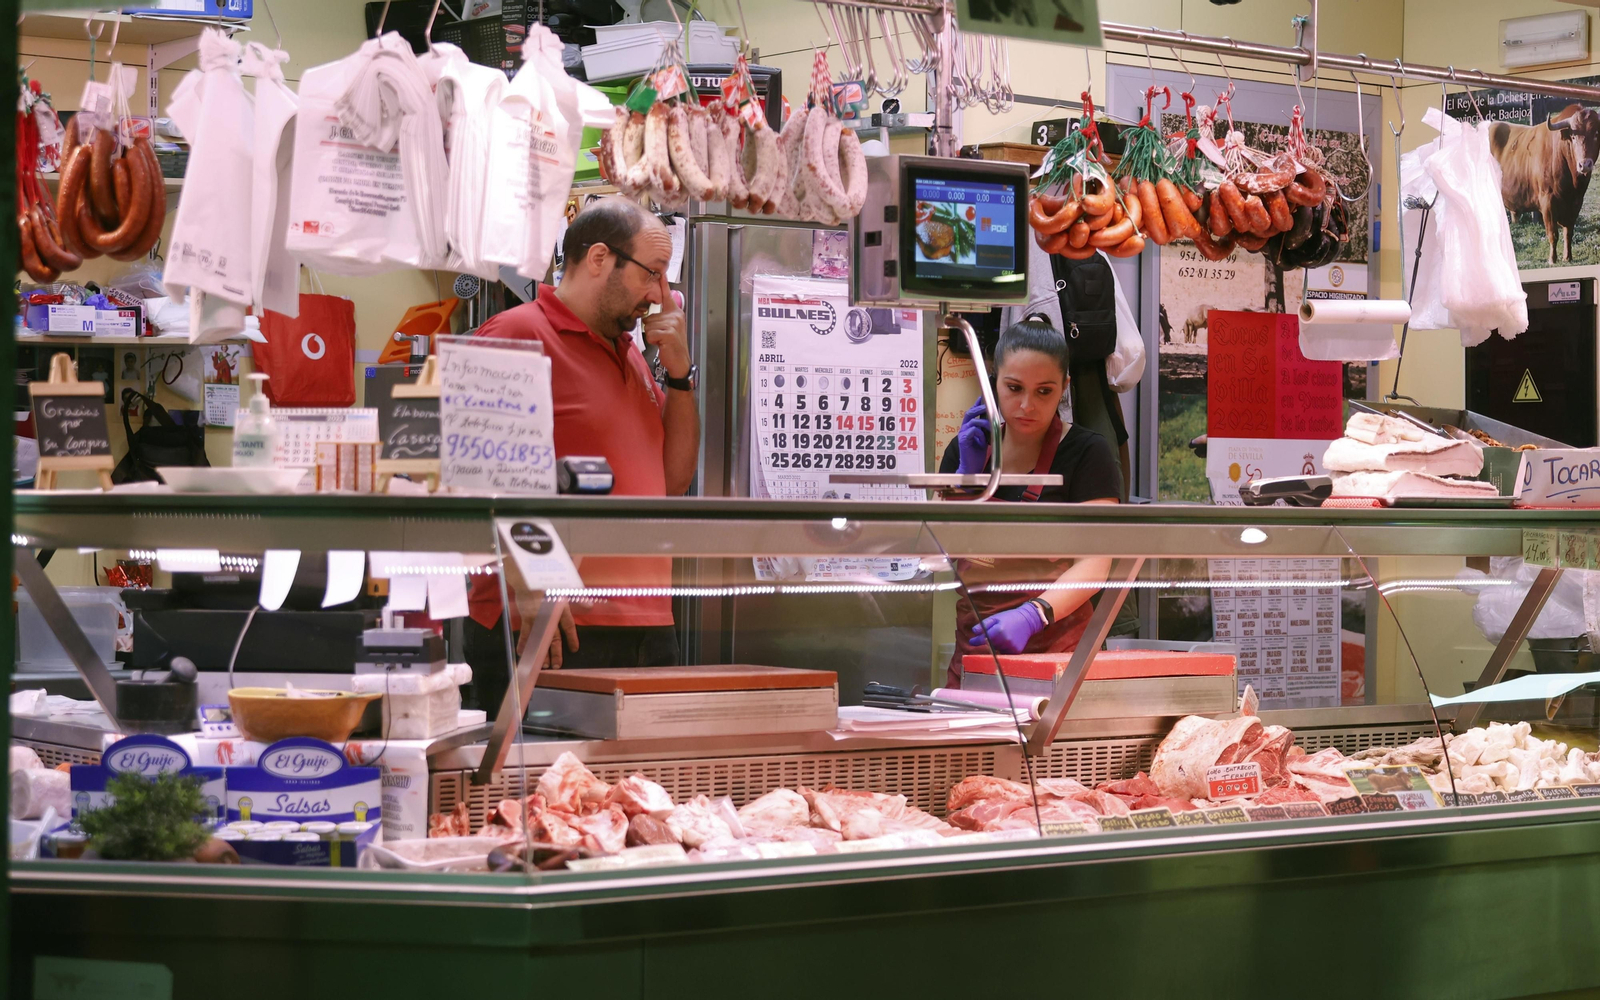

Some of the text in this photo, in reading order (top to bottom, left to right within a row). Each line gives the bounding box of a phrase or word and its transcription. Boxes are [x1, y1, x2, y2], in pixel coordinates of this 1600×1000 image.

[1447, 100, 1454, 110] El
[1458, 98, 1472, 112] Rey
[1476, 96, 1484, 106] de
[1488, 94, 1494, 105] la
[1497, 92, 1528, 104] Dehesa
[1486, 110, 1496, 120] de
[1498, 108, 1531, 121] Badajoz
[948, 191, 965, 200] 0,000
[976, 194, 990, 202] 0,00
[1001, 195, 1014, 204] 0,00
[1180, 250, 1196, 262] 954
[1178, 267, 1236, 280] 652 81 35 29
[758, 307, 830, 320] BULNES
[83, 320, 93, 331] M
[1213, 318, 1270, 346] Toros
[759, 354, 918, 368] ABRIL 2022
[1214, 348, 1270, 376] en Se
[761, 378, 912, 393] 13 1 2 3
[41, 398, 100, 418] Gracias
[775, 394, 783, 409] 4
[796, 395, 806, 410] 5
[819, 395, 829, 410] 6
[840, 396, 850, 411] 7
[861, 397, 871, 411] 8
[882, 397, 892, 412] 9
[900, 398, 917, 412] 10
[761, 414, 916, 431] 15 11 12 13 14 15 16 17
[1214, 407, 1268, 431] 2022
[763, 433, 918, 450] 16 18 19 20 21 22 23 24
[447, 434, 553, 470] 955061853
[765, 453, 896, 469] 17 25 26 27 28 29 30
[1543, 457, 1600, 485] TOCAR
[120, 752, 174, 772] El Guijo
[275, 753, 329, 773] El Guijo
[267, 794, 331, 814] Salsas
